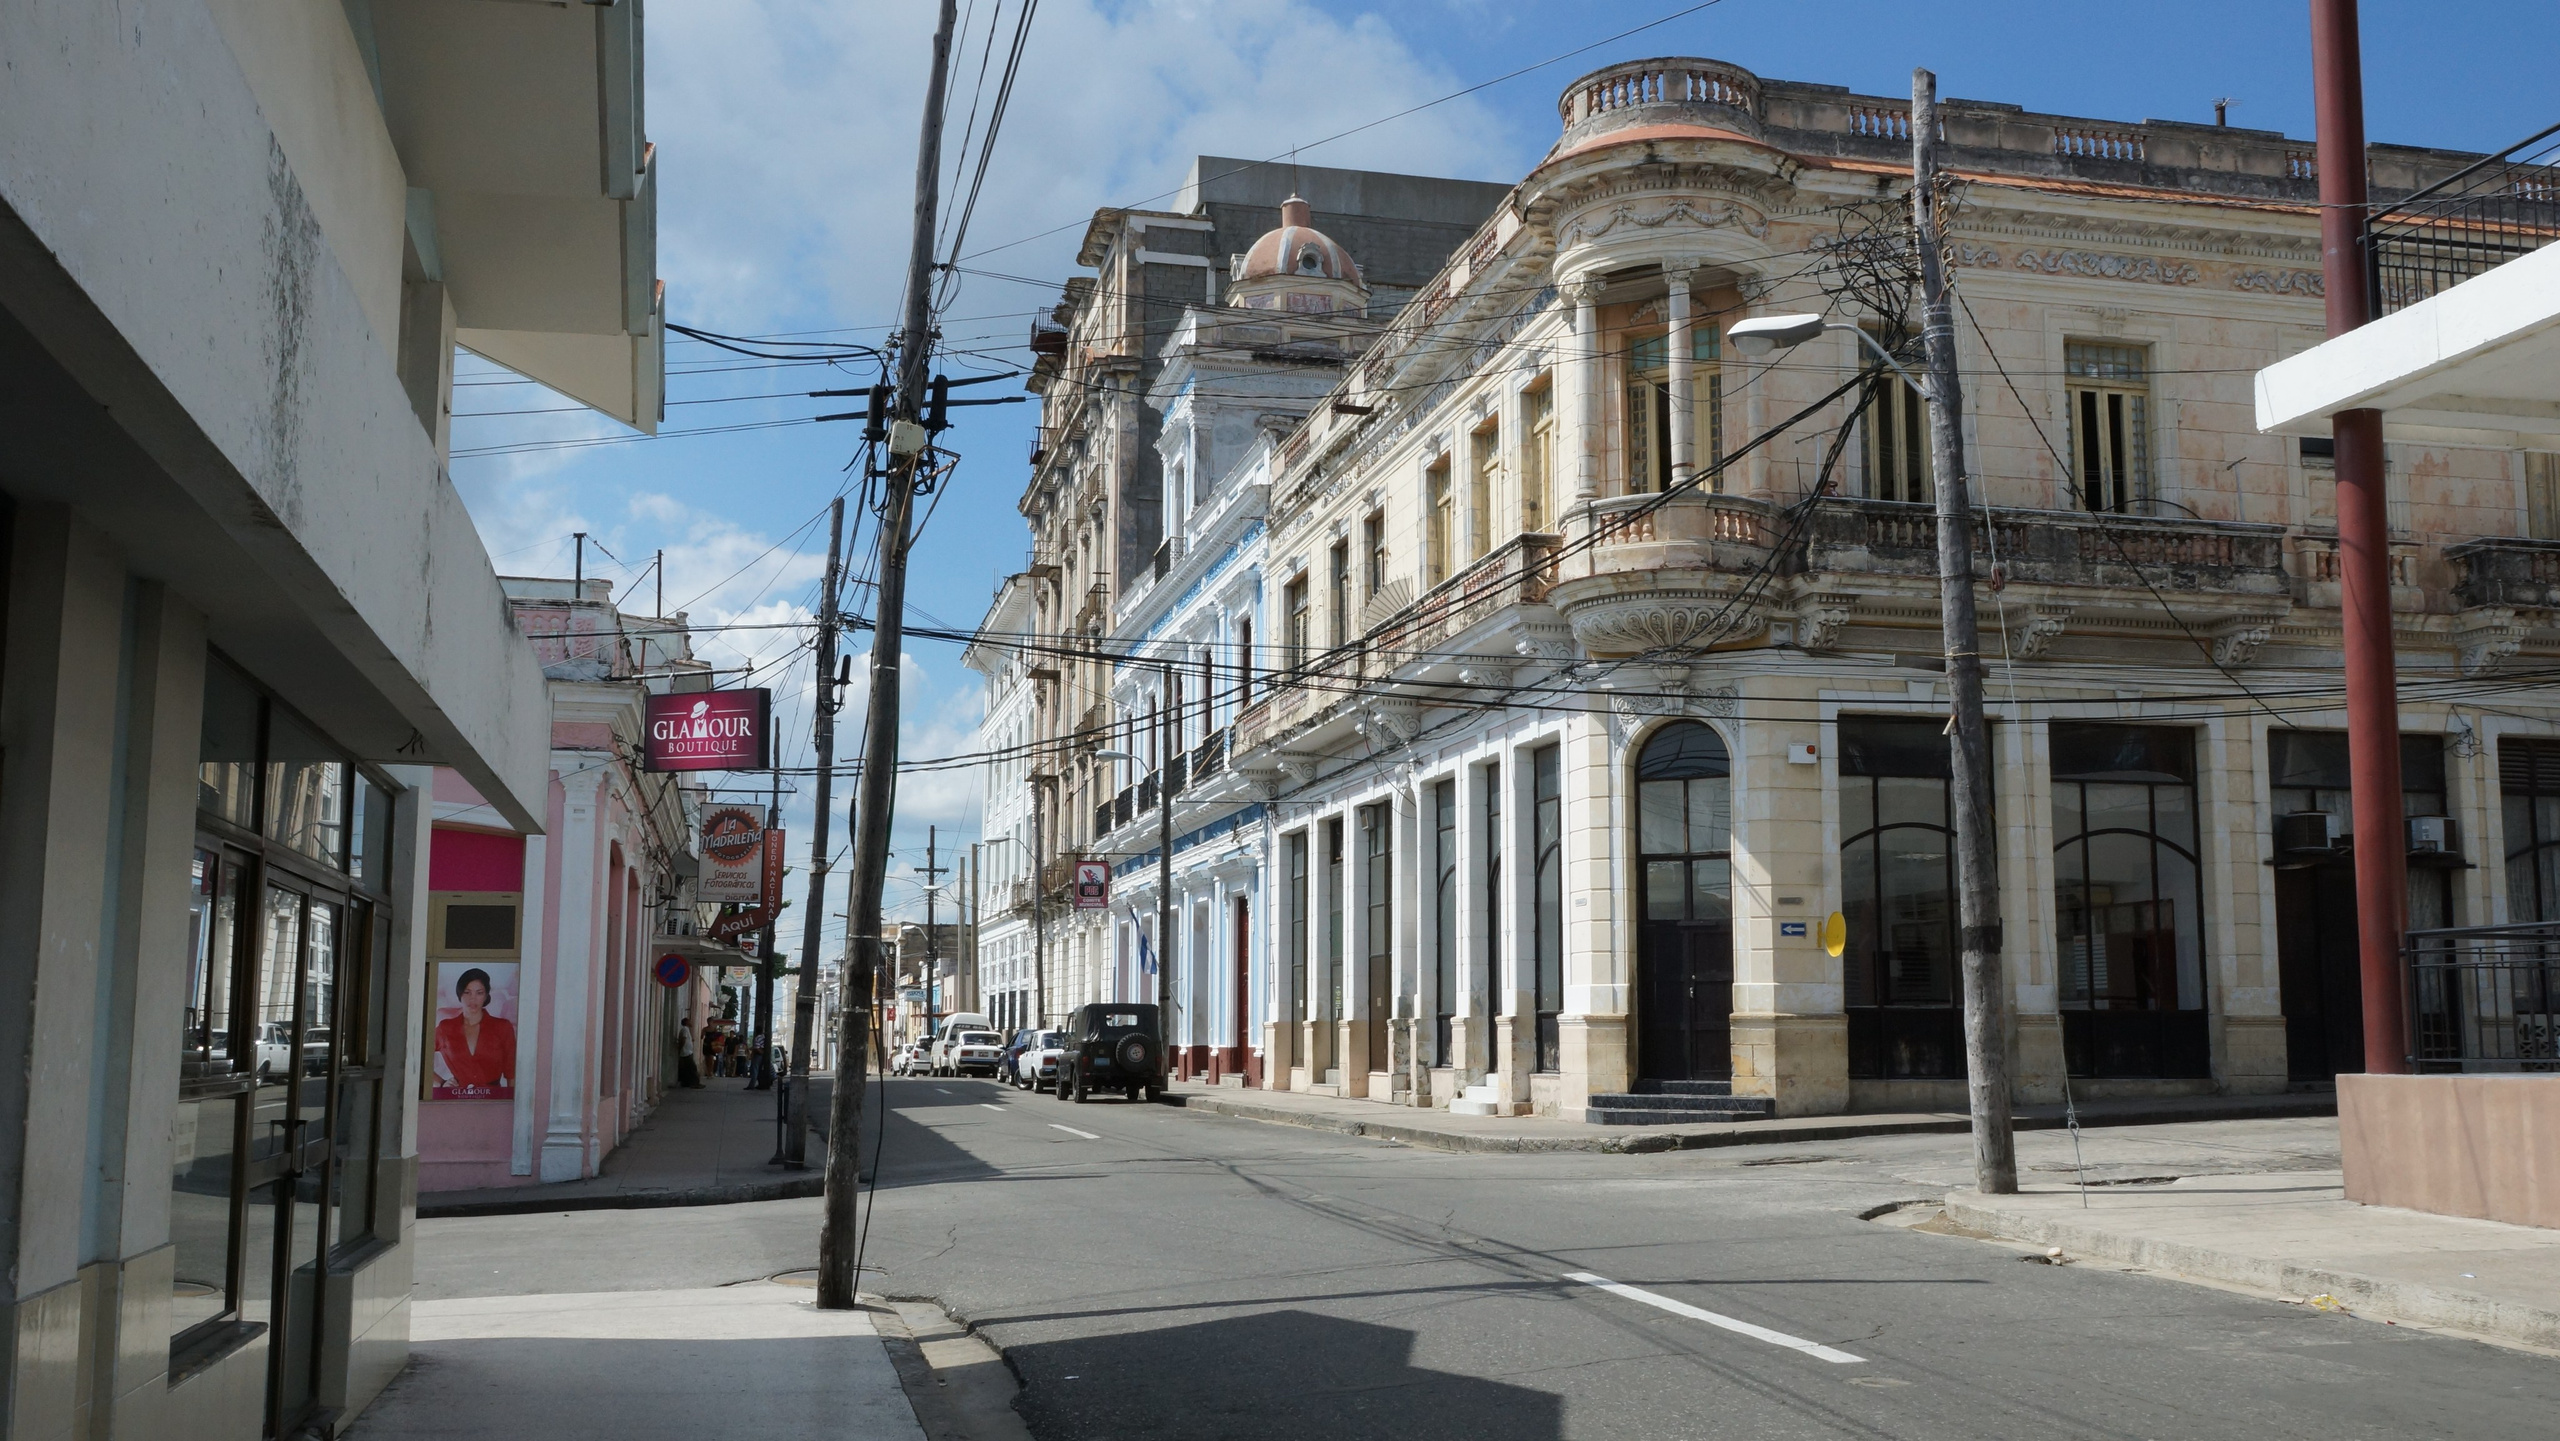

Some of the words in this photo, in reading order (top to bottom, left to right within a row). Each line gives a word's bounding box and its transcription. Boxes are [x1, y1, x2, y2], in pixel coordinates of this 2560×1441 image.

[653, 717, 752, 740] GLAMOUR
[668, 740, 737, 753] BOUTIQUE
[722, 817, 737, 834] LA
[700, 829, 763, 852] MADRILEÑA
[770, 830, 778, 867] MONEDA
[713, 870, 748, 880] SERVICIOS
[768, 870, 776, 921] NACIONAL
[721, 913, 754, 935] AQUÍ
